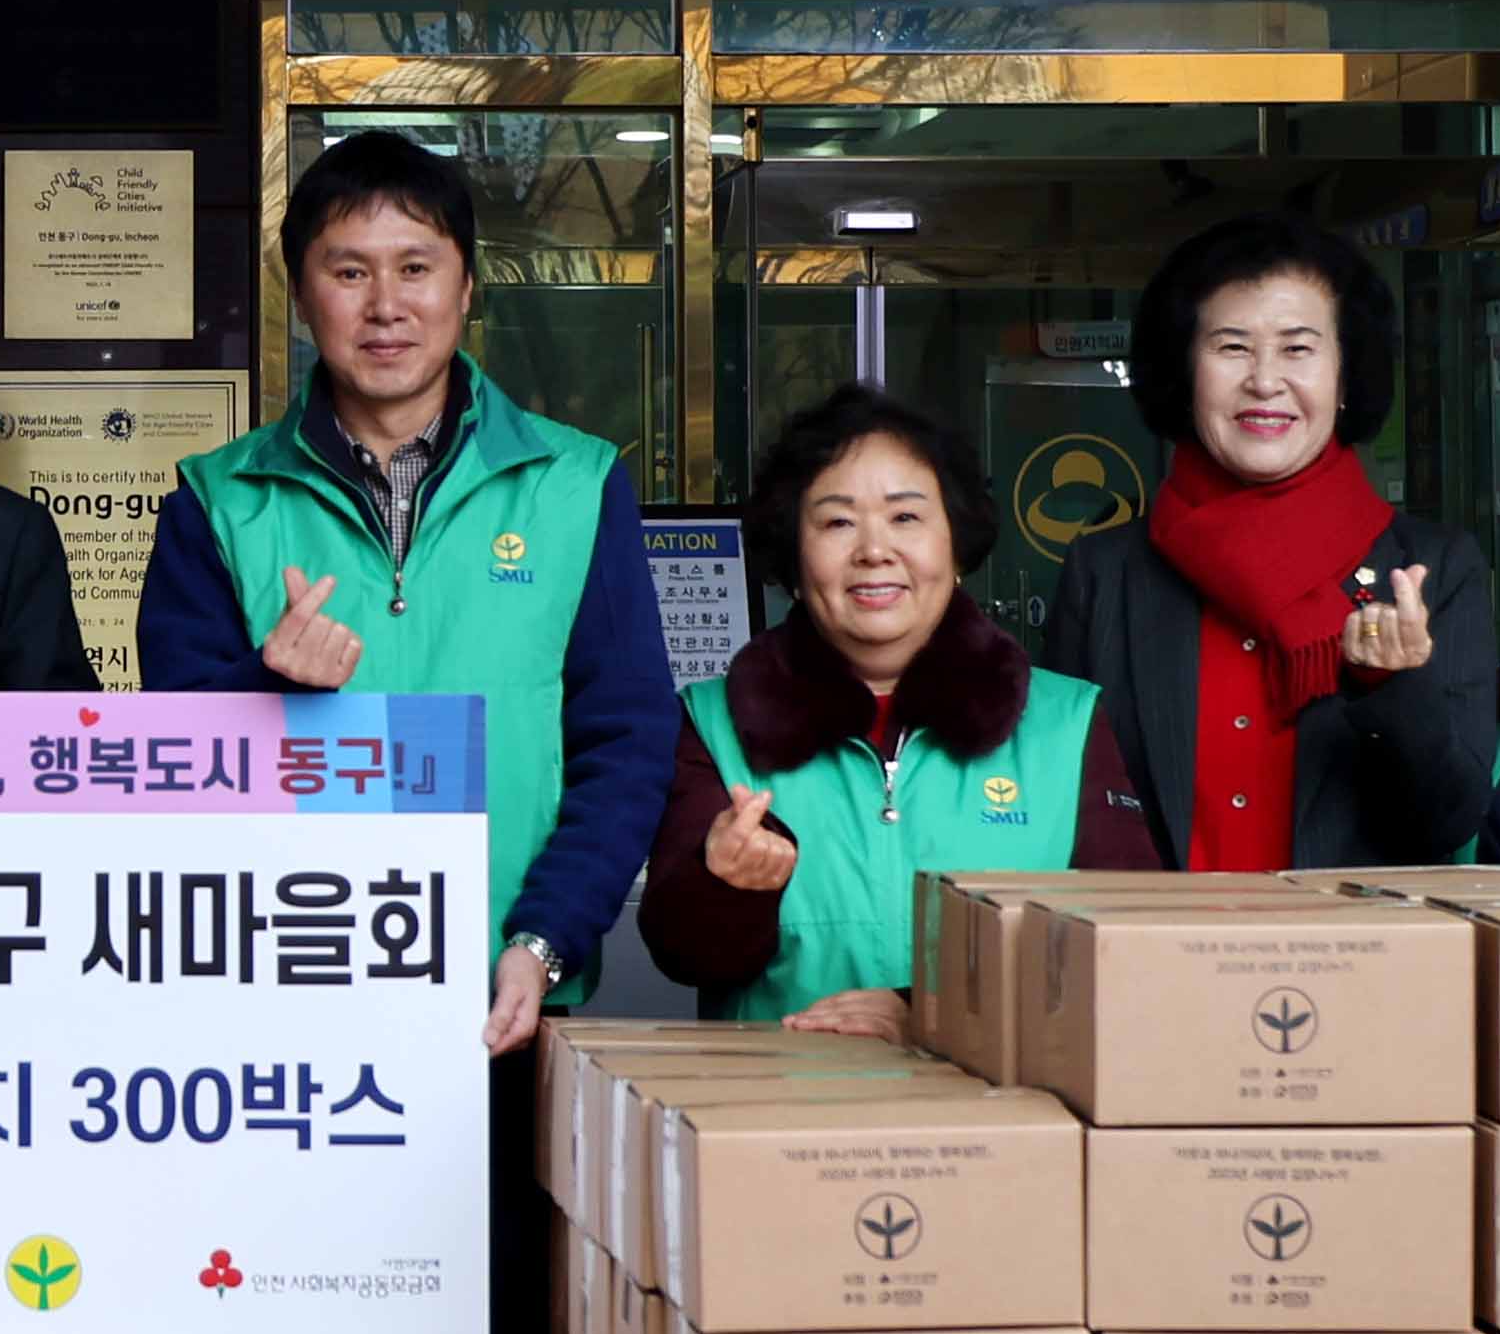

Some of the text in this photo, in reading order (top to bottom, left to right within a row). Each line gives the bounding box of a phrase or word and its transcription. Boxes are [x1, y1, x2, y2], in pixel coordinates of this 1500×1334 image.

[116, 169, 144, 179] Child
[116, 180, 158, 191] Friendly
[116, 192, 146, 202] Cities
[116, 203, 163, 213] Initiative
[75, 299, 107, 311] unicef
[17, 415, 83, 427] World Health
[17, 427, 83, 439] Organization
[29, 470, 167, 485] This is to certify that
[29, 485, 164, 520] Dong-gu
[64, 530, 117, 543] member
[120, 529, 135, 543] of
[644, 533, 717, 550] ATION
[67, 548, 152, 564] alth Organiza
[98, 568, 116, 581] for
[119, 568, 145, 583] Age
[488, 568, 534, 585] SMU
[665, 586, 728, 599] 조사무실
[667, 613, 729, 625] 난상황실
[669, 637, 730, 649] 전관리과
[83, 646, 127, 673] 역시
[29, 736, 251, 795] 행복도시
[981, 810, 1028, 825] SMU
[82, 868, 447, 986] 새마을회
[68, 1062, 406, 1151] 300박스
[251, 1273, 441, 1299] 인천 사회복지공동모금회
